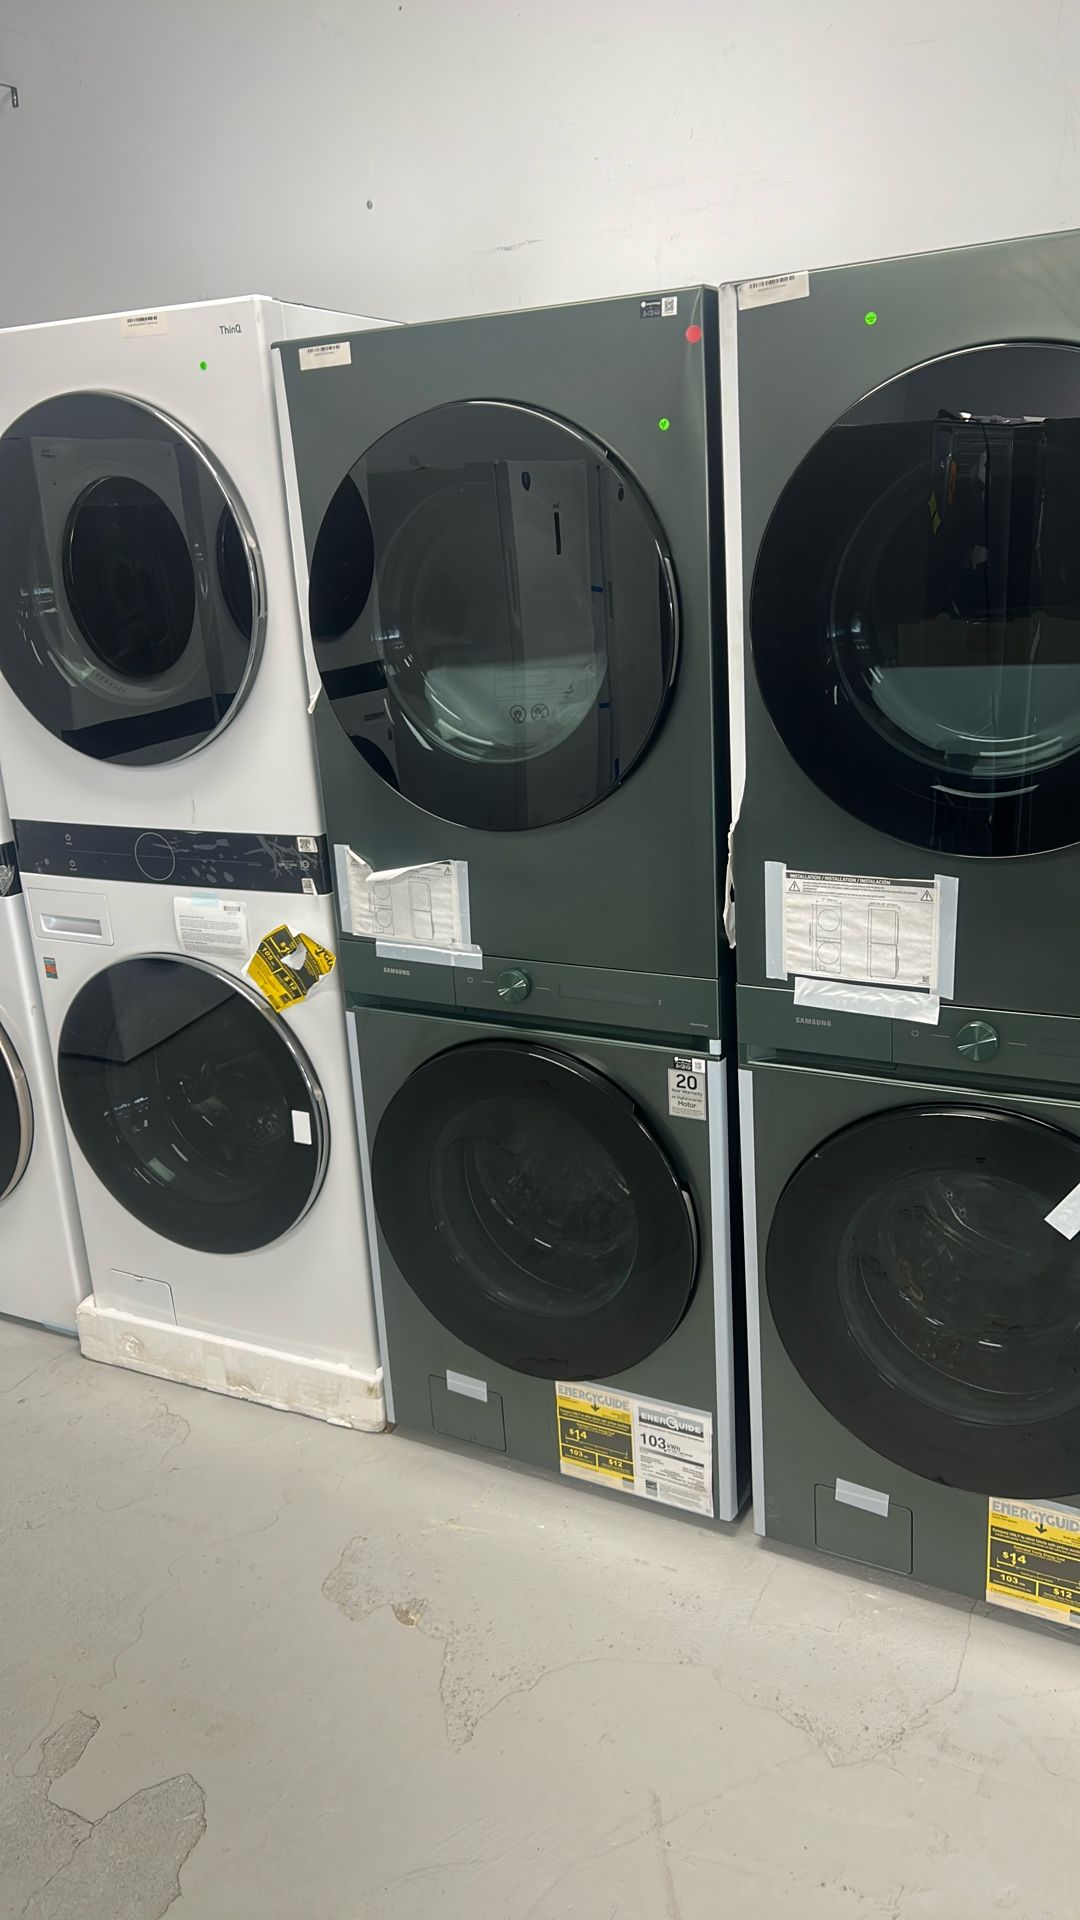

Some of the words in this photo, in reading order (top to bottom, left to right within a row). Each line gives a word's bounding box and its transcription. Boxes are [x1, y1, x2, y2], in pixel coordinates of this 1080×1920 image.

[219, 324, 242, 335] ThinQ
[383, 967, 410, 976] SAMSUNG
[795, 1017, 832, 1027] SAMSUNG
[676, 1073, 697, 1090] 20
[678, 1100, 696, 1109] Motor
[558, 1385, 630, 1411] ENERGYGUIDE
[569, 1428, 587, 1440] $14
[640, 1433, 666, 1450] 103
[569, 1448, 583, 1457] 103
[608, 1458, 623, 1468] $12
[992, 1500, 1080, 1532] ENERGYGUID
[1002, 1551, 1026, 1564] $14
[1000, 1574, 1018, 1584] 103
[1052, 1588, 1072, 1599] $12
